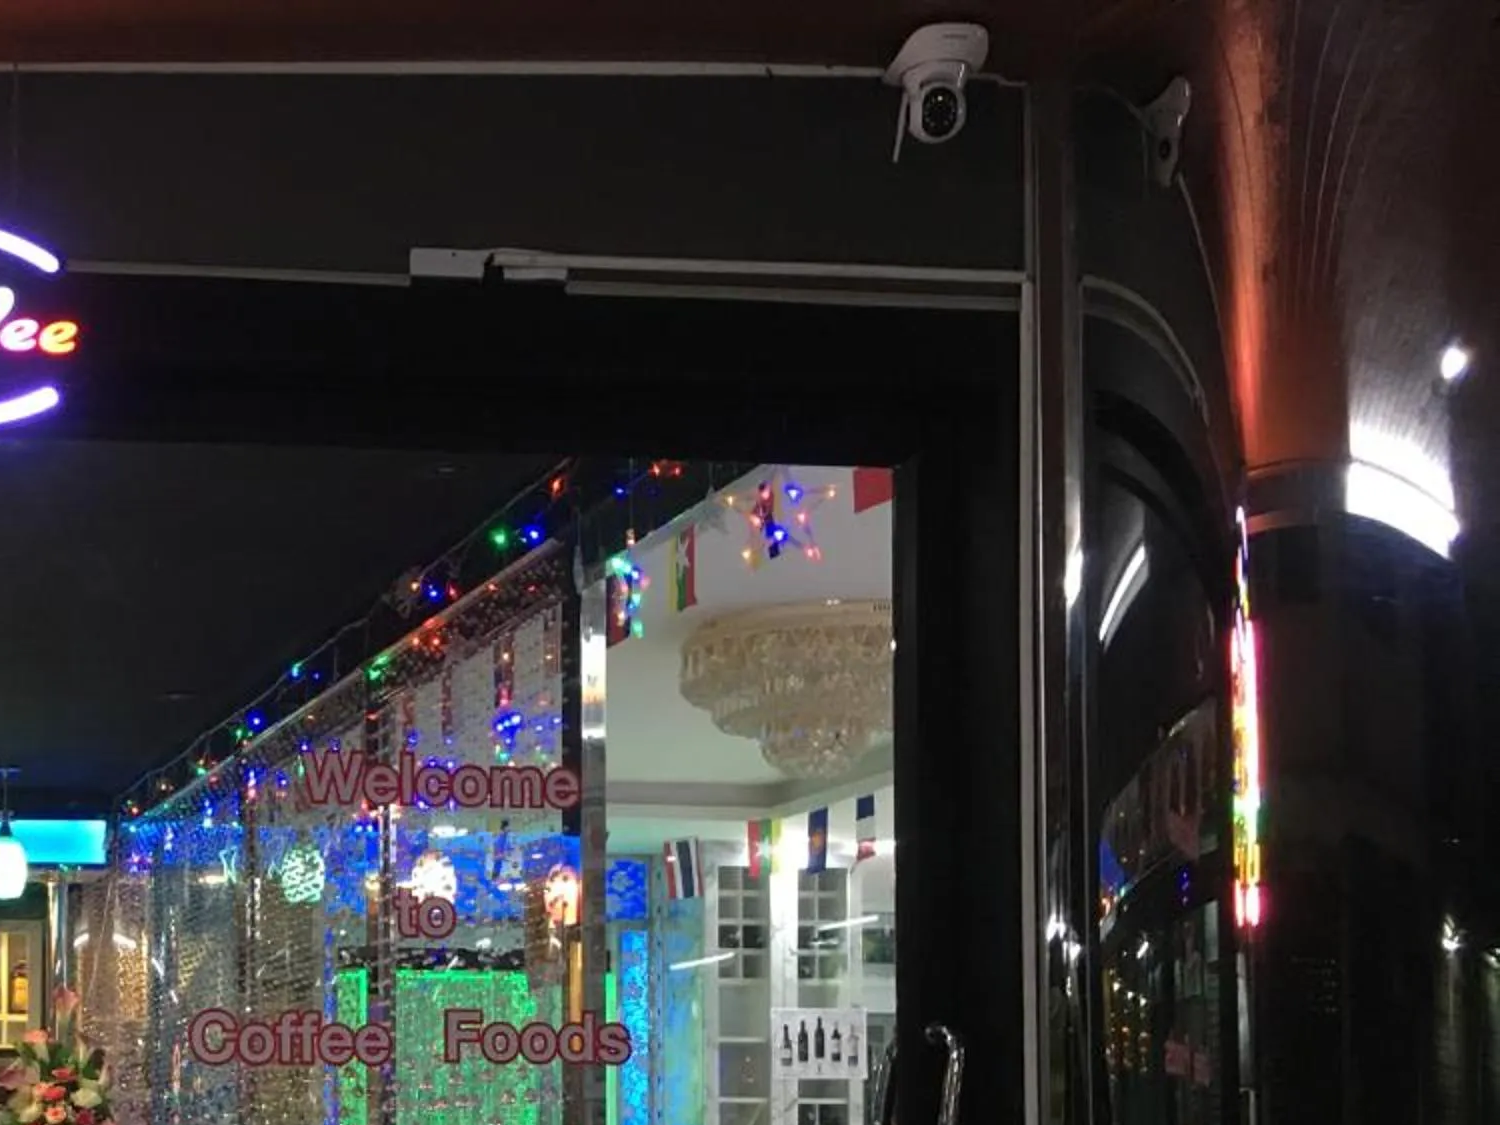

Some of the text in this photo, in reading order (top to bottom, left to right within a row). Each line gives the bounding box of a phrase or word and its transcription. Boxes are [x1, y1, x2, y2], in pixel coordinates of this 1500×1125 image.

[303, 750, 581, 809] Welcome
[392, 892, 456, 938] to
[189, 1010, 633, 1066] Coffee Foods
